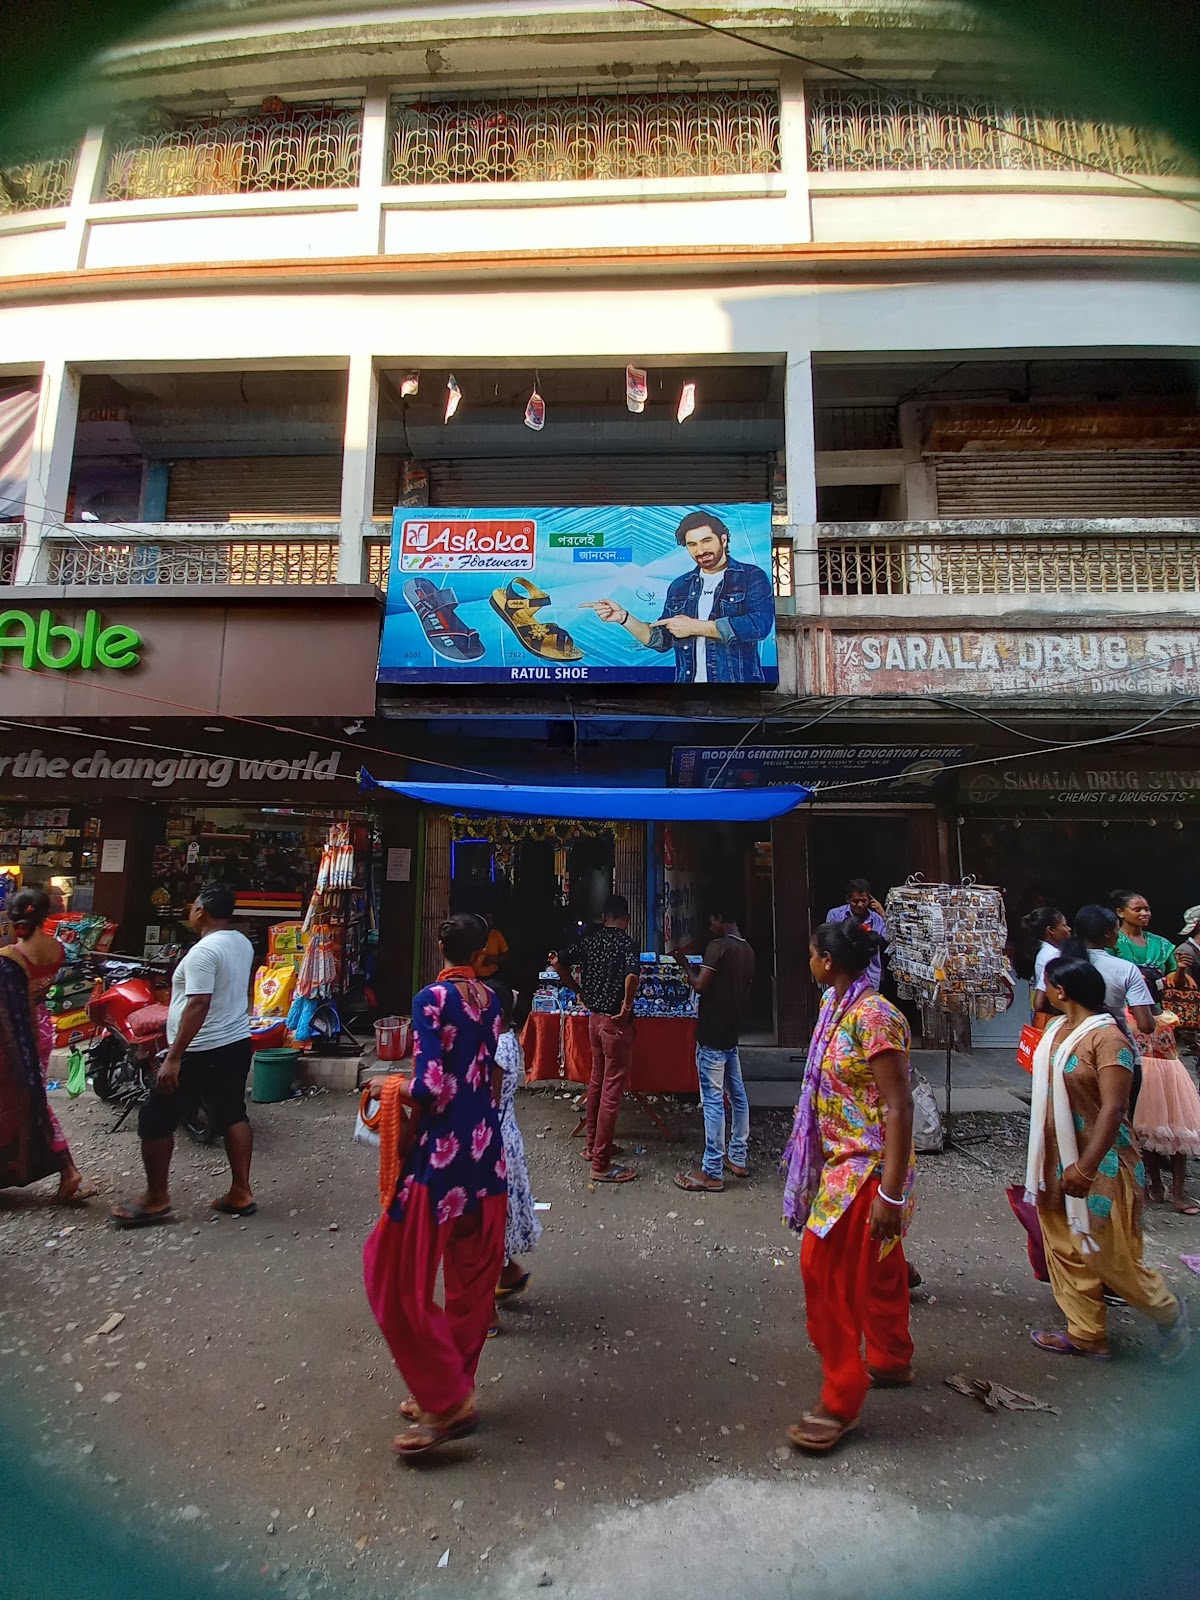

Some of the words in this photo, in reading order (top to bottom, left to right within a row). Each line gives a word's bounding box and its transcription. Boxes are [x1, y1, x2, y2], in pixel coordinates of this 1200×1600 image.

[416, 527, 530, 552] Ashoka
[557, 534, 596, 546] পরলেই
[458, 554, 528, 569] Footwear
[0, 608, 145, 671] Able
[861, 635, 1001, 671] SARALA
[1018, 635, 1129, 671] DRUG
[511, 667, 551, 680] RATUL
[554, 667, 589, 680] SHOE
[702, 751, 745, 760] MODERN
[747, 750, 808, 760] GENERATION
[857, 748, 919, 758] EDUCATION
[71, 750, 234, 788] changing
[239, 751, 342, 781] world
[1003, 771, 1081, 790] SARALA
[1086, 771, 1141, 791] DRUG
[1057, 791, 1108, 802] CHEMIST
[1118, 791, 1189, 803] DRUGGISTS
